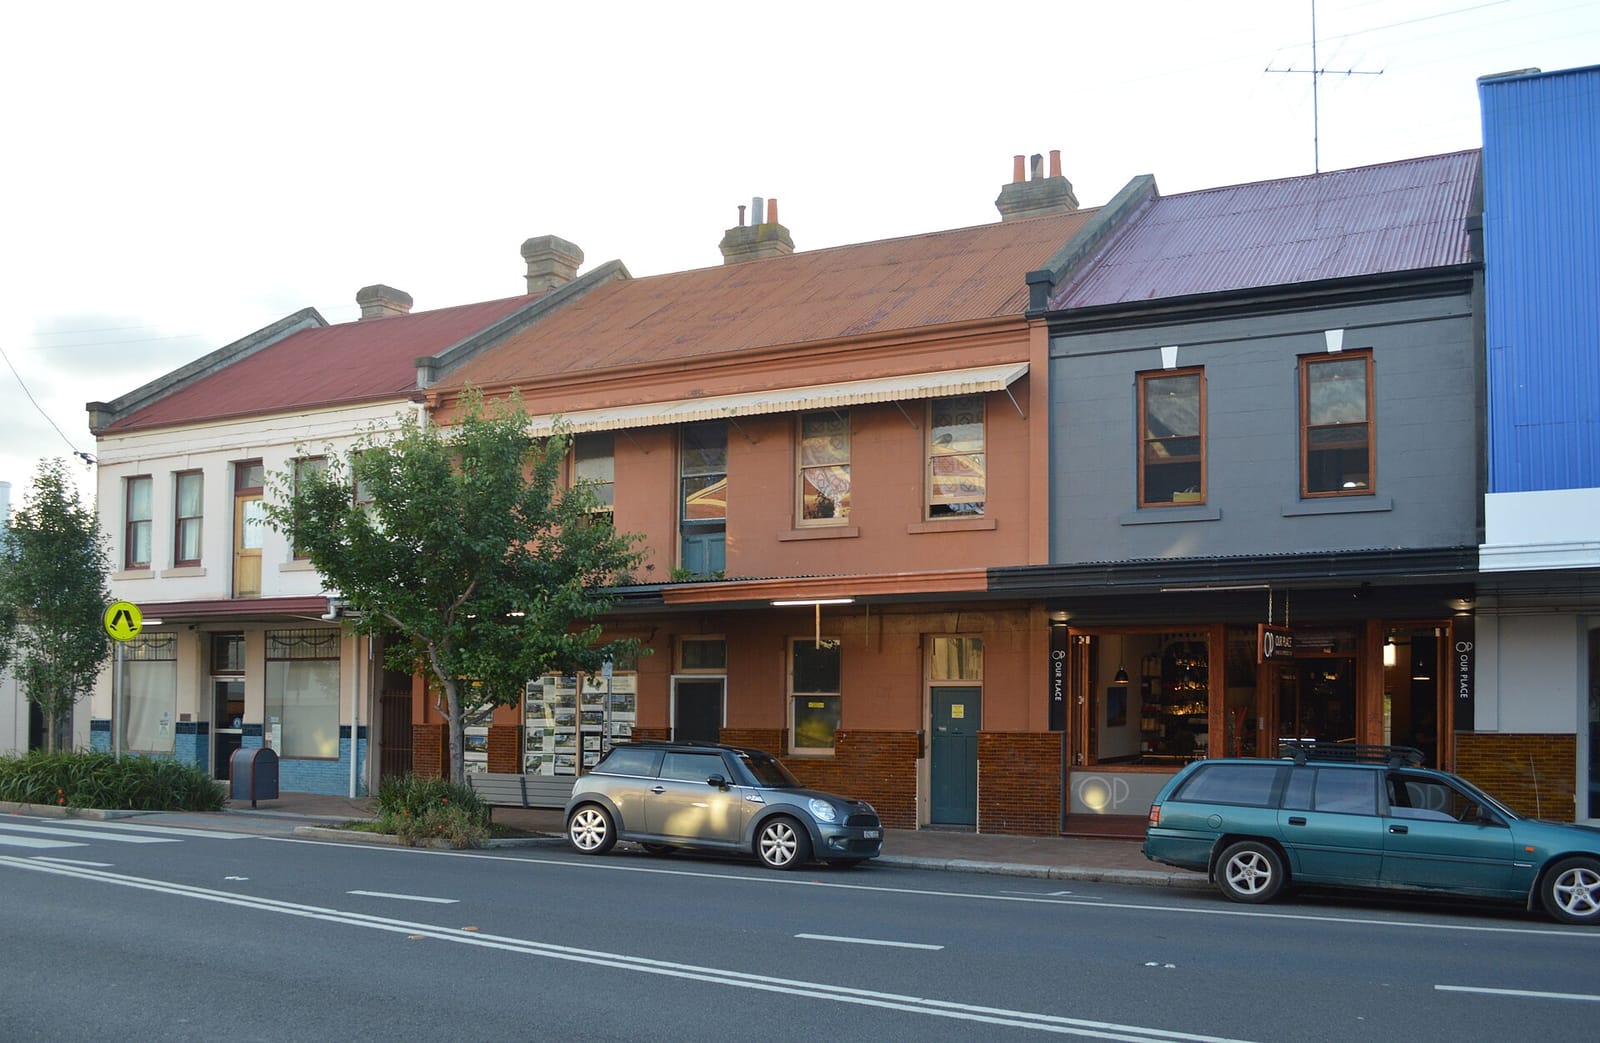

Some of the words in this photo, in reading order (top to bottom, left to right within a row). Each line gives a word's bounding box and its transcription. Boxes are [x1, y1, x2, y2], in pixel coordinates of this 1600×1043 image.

[1460, 654, 1469, 672] OUR
[1460, 674, 1469, 699] PLACE
[1078, 775, 1130, 810] OP
